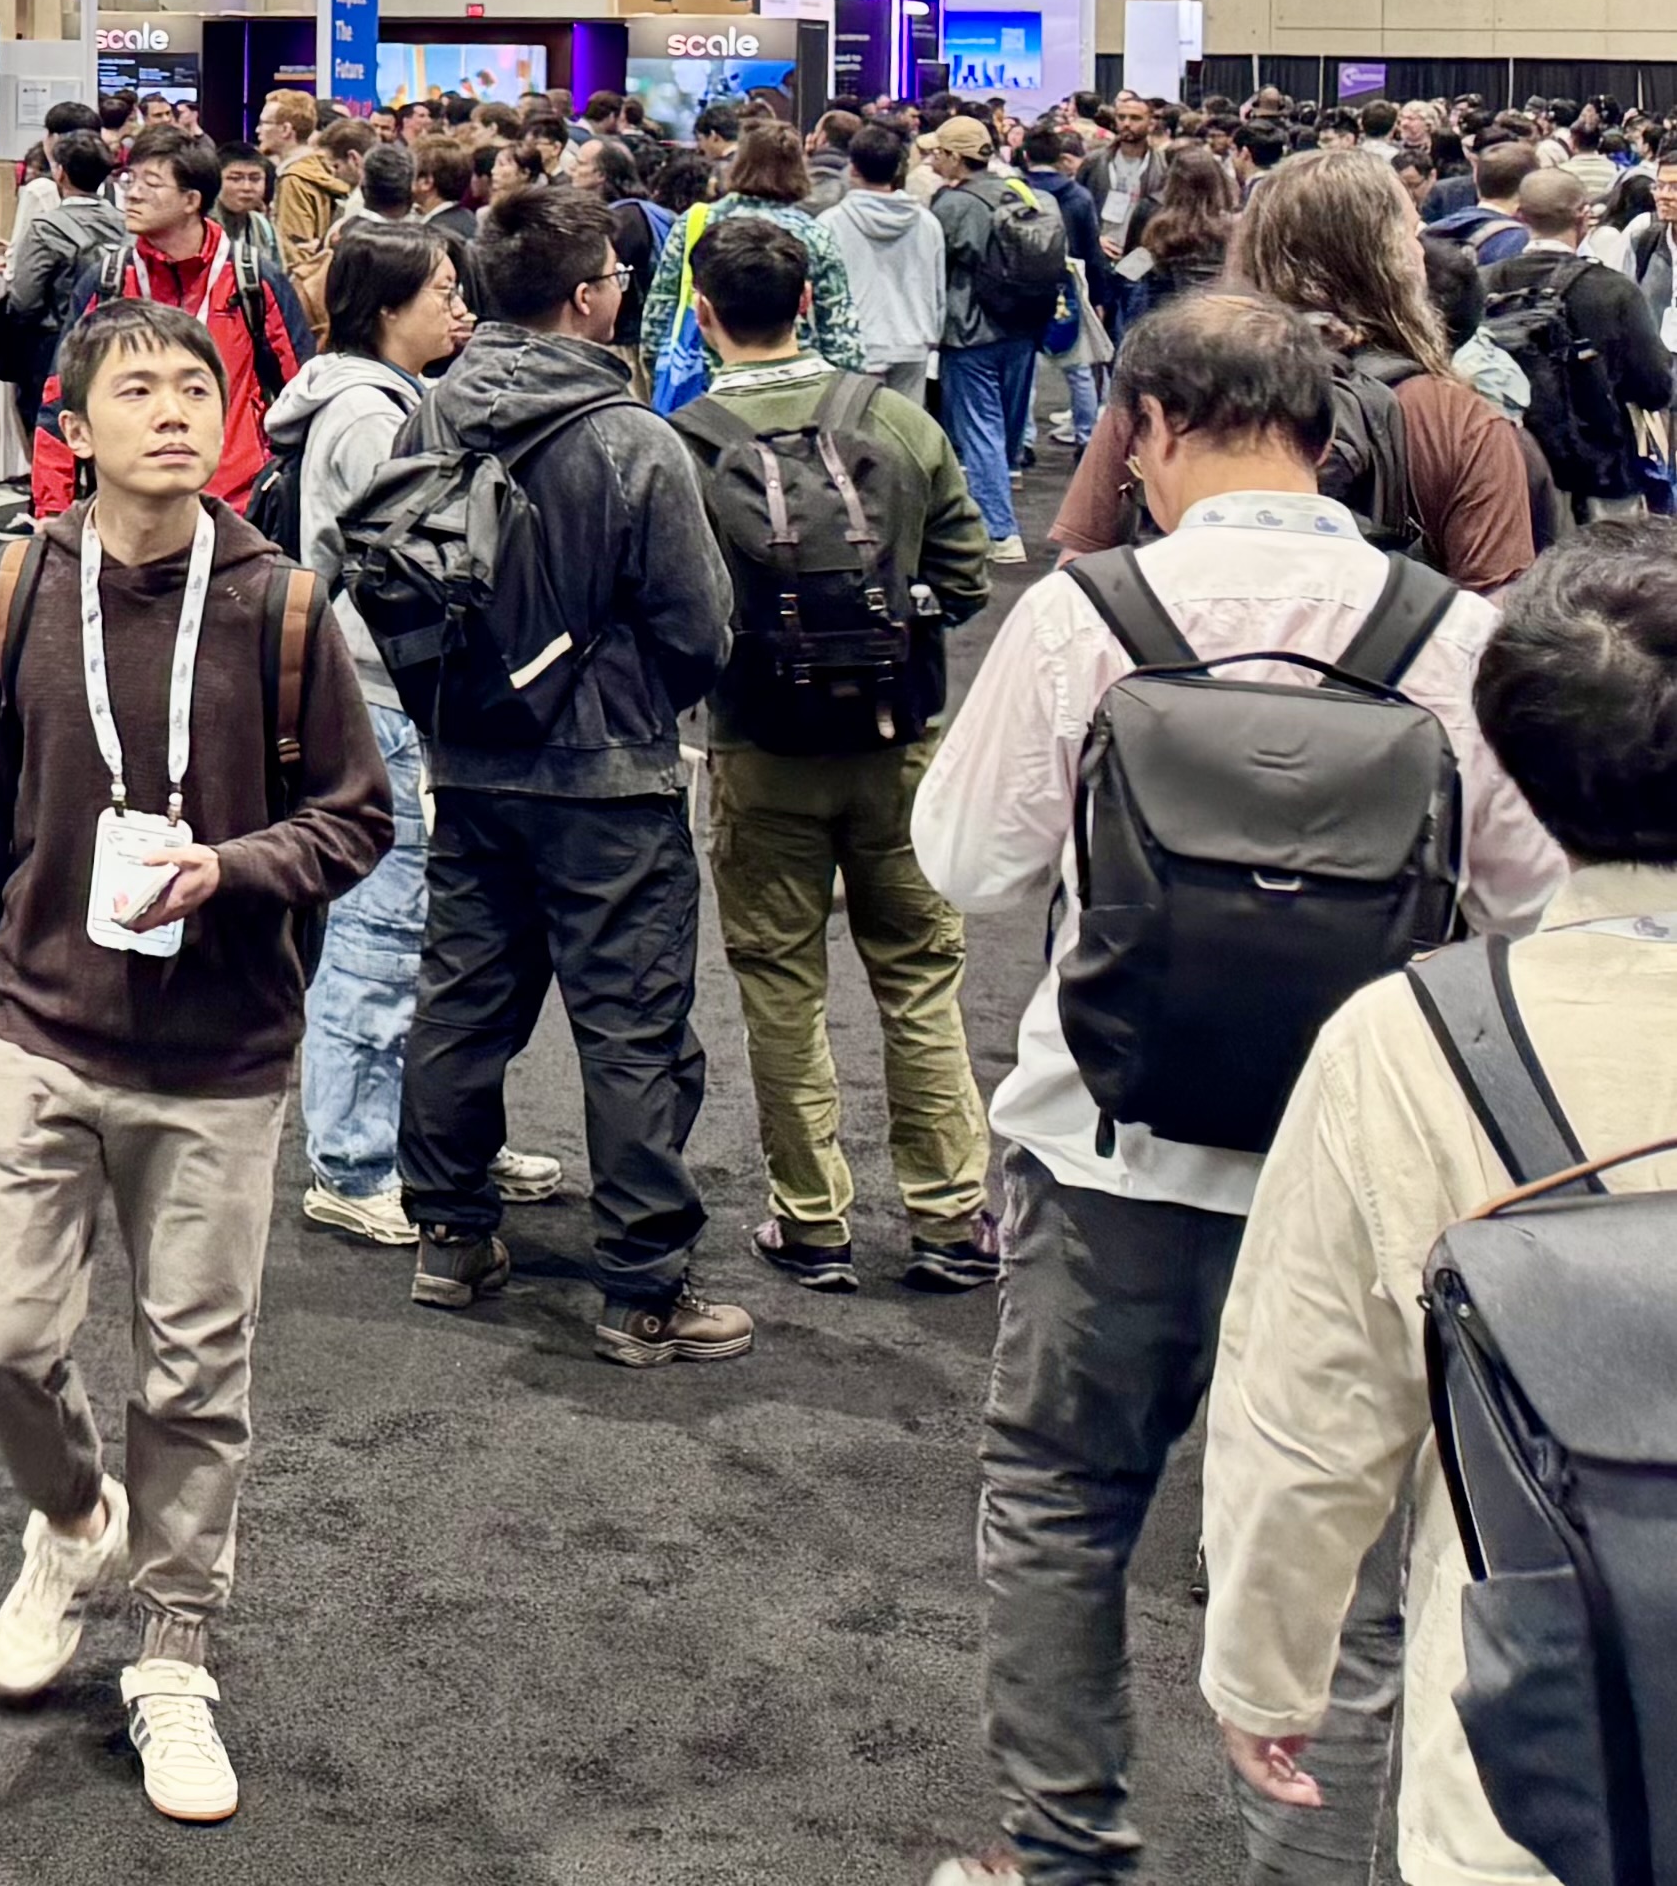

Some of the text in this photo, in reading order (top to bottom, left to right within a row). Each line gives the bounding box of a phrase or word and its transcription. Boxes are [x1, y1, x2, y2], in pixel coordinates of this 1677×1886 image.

[95, 21, 170, 51] scale
[667, 26, 760, 58] scale
[335, 58, 364, 80] Future
